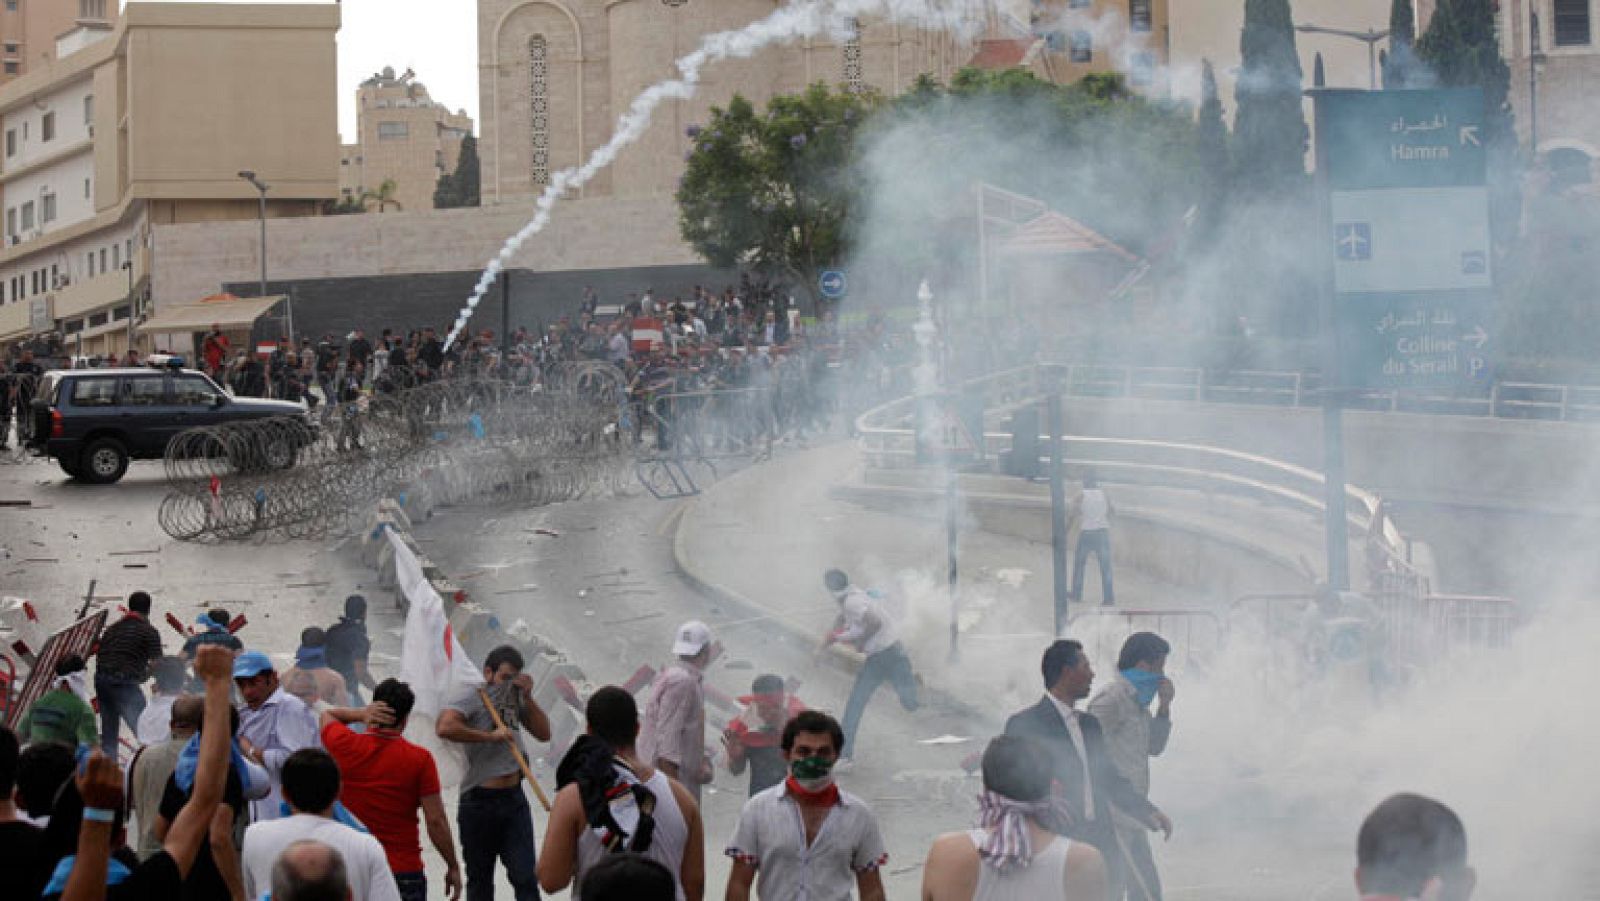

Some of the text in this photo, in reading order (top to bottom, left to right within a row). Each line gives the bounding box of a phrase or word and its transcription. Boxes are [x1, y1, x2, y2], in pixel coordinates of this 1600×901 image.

[1391, 144, 1449, 160] Hamra
[1397, 336, 1456, 353] Colline
[1383, 357, 1405, 374] du
